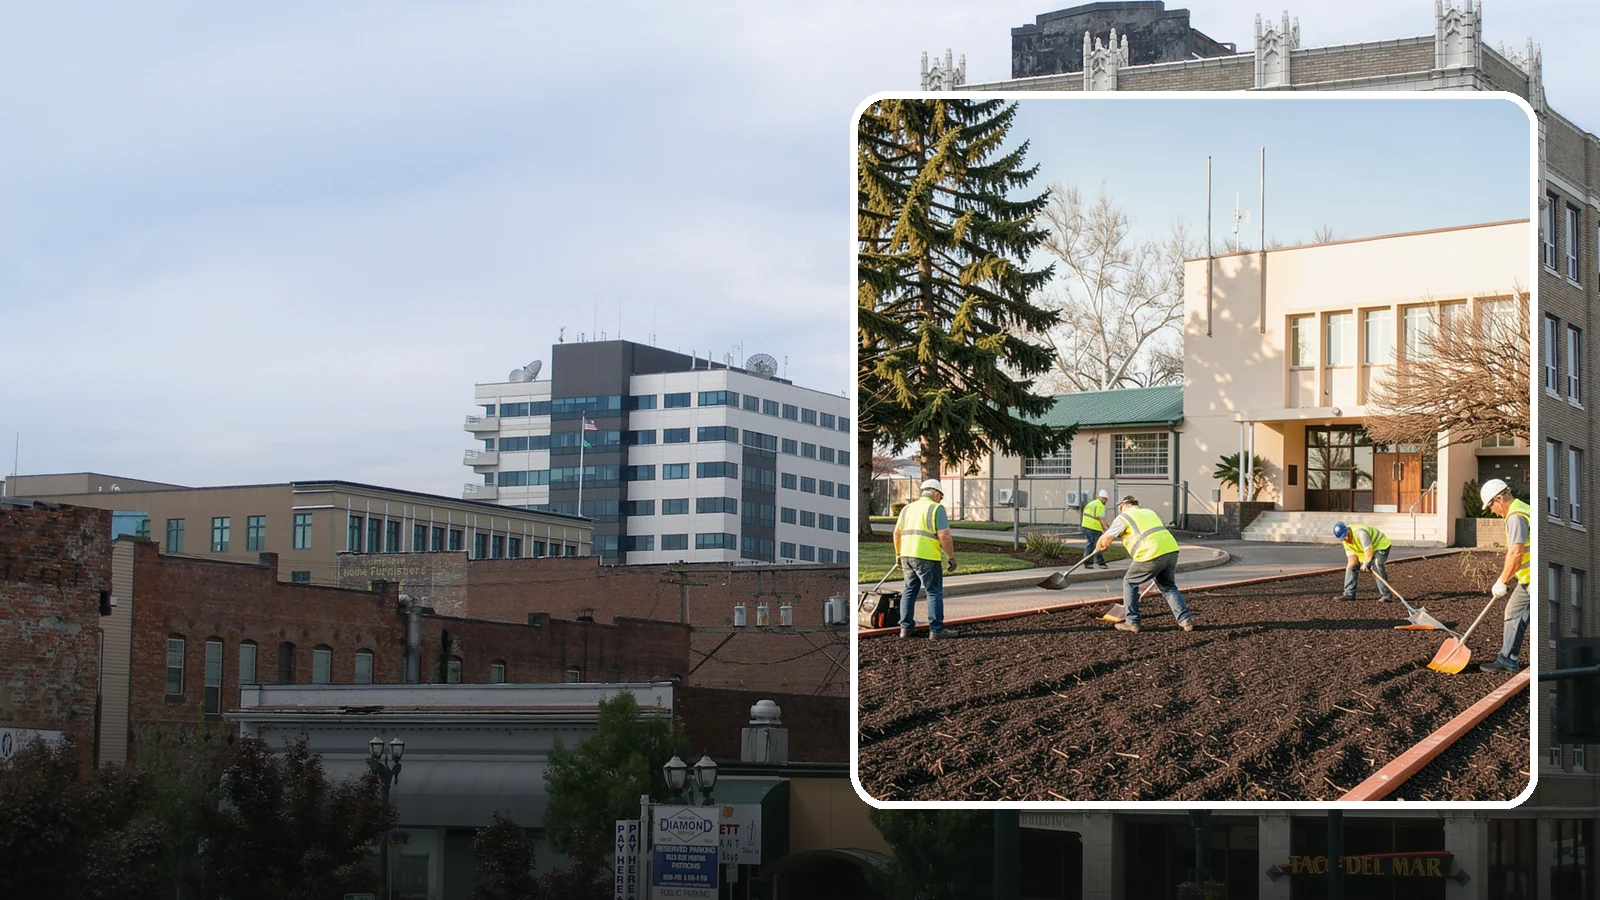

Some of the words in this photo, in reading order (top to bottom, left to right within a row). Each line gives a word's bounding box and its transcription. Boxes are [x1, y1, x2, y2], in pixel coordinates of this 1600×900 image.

[660, 818, 713, 833] DIAMOND
[1021, 815, 1070, 828] BUILDING
[617, 825, 625, 852] PAY
[628, 824, 637, 852] PAY
[655, 845, 688, 853] RESERVED
[689, 846, 716, 854] PARKING
[721, 851, 739, 862] Soup
[671, 862, 701, 870] PATRONS
[1288, 855, 1329, 874] TAC
[1346, 856, 1385, 875] DEL
[1392, 857, 1442, 877] MAR
[617, 856, 625, 893] HERE
[628, 855, 636, 893] HERE
[660, 888, 682, 897] PUBLIC
[683, 889, 710, 899] PARKING
